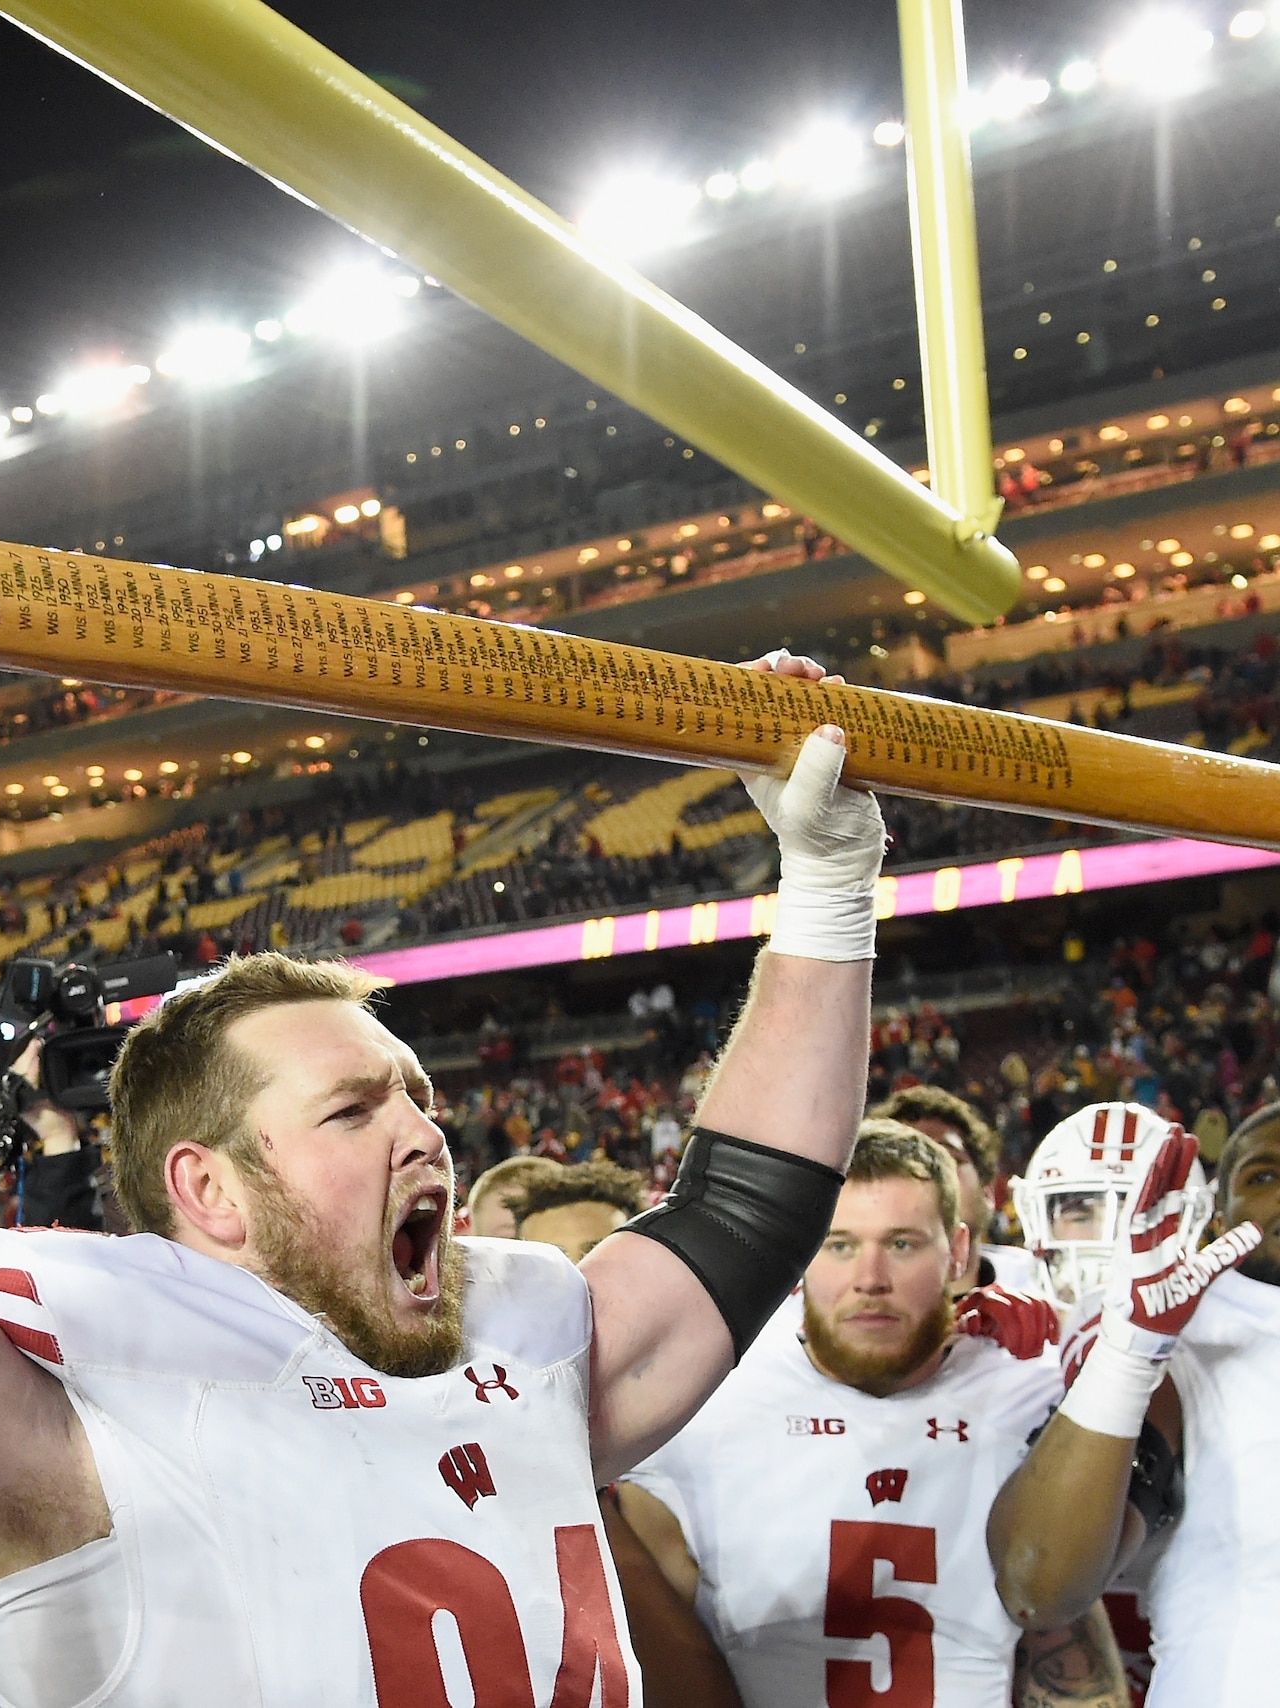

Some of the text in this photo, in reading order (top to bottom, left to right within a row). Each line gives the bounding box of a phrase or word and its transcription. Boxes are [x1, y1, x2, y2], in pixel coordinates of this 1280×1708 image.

[1, 573, 14, 597] 1924
[30, 576, 44, 601] 1925
[58, 578, 71, 606] 1930
[86, 585, 99, 609] 1932
[116, 589, 129, 614] 1942
[142, 594, 155, 618] 1945
[171, 600, 184, 622] 1950
[197, 604, 209, 626] 1951
[223, 608, 236, 630] 1952
[250, 610, 263, 634] 1953
[276, 615, 288, 637] 1954
[1137, 1221, 1263, 1318] WISCONSIN
